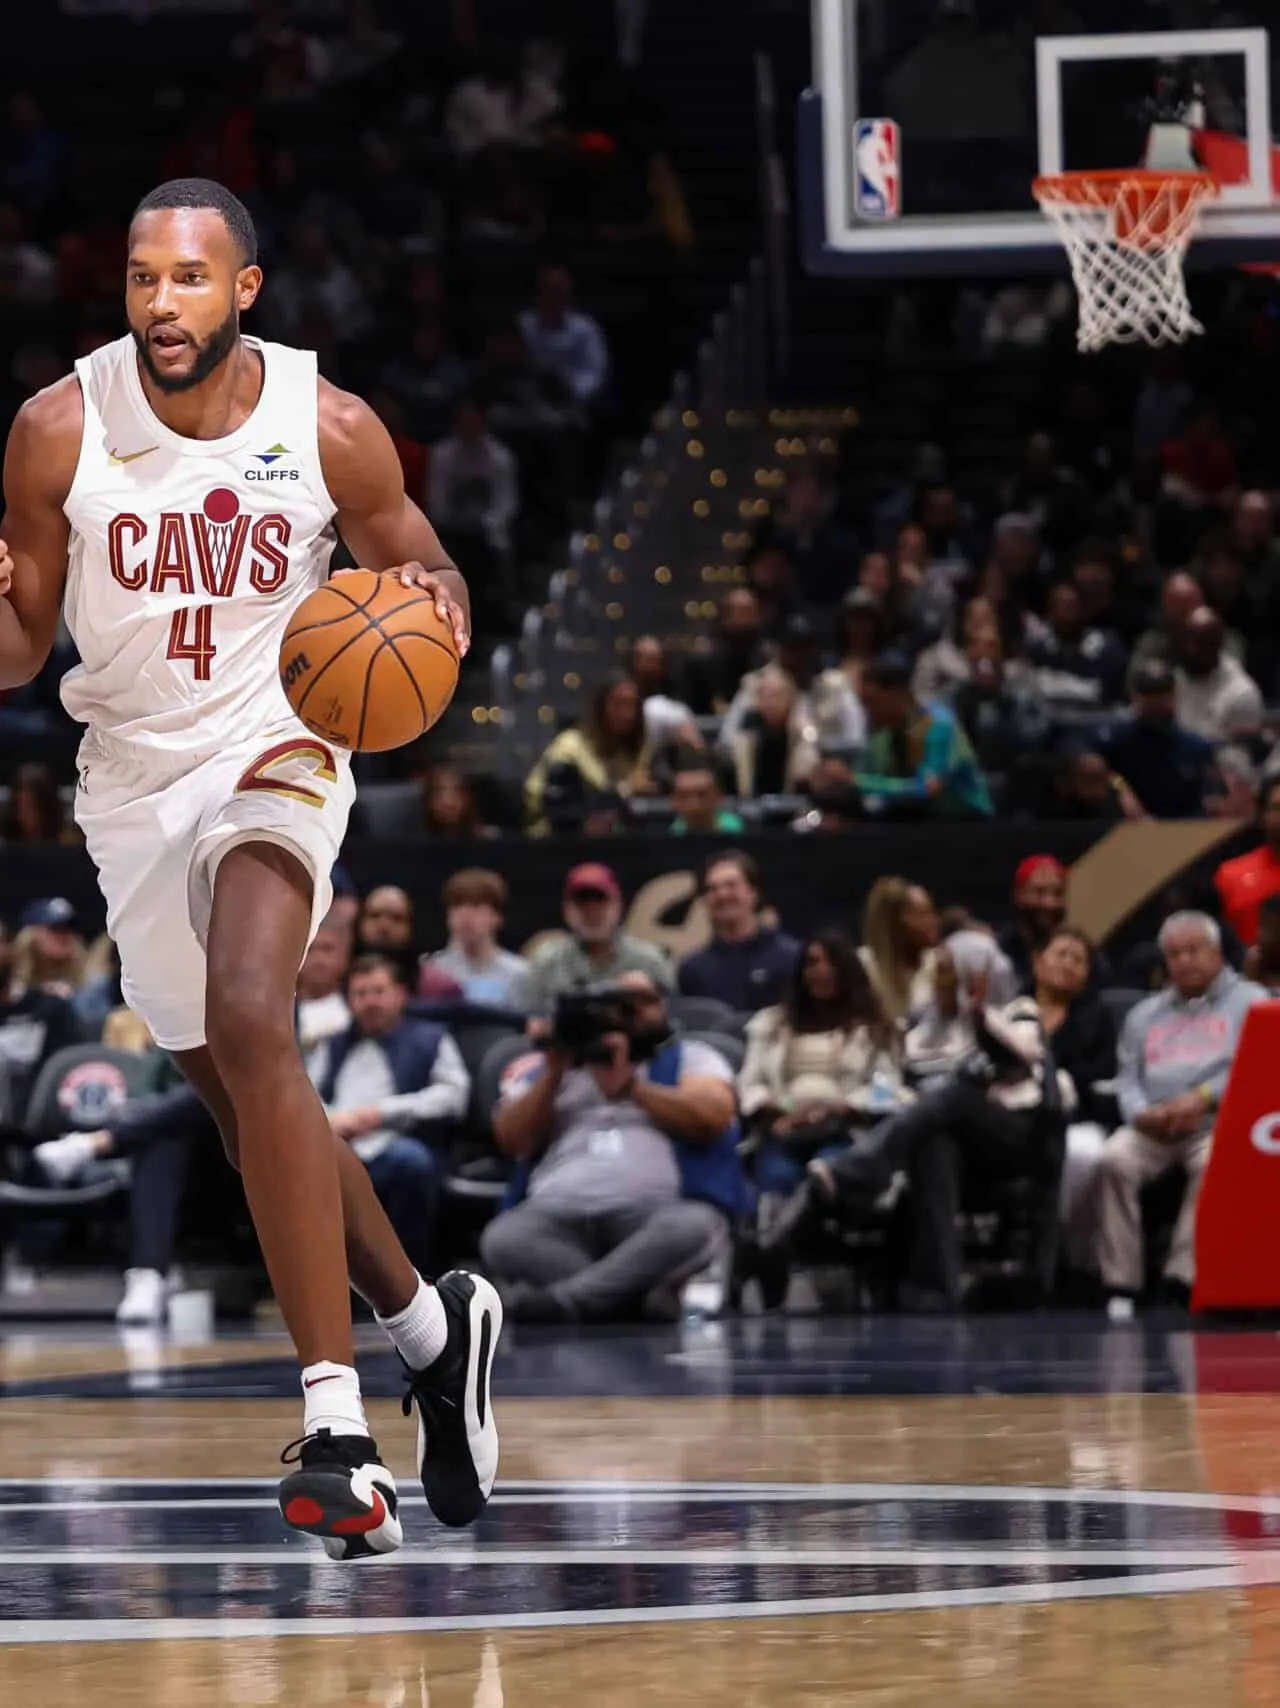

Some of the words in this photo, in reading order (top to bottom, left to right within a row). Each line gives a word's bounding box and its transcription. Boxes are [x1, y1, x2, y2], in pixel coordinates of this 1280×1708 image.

[244, 470, 299, 481] CLIFFS
[107, 511, 293, 597] CAVS
[166, 604, 217, 681] 4
